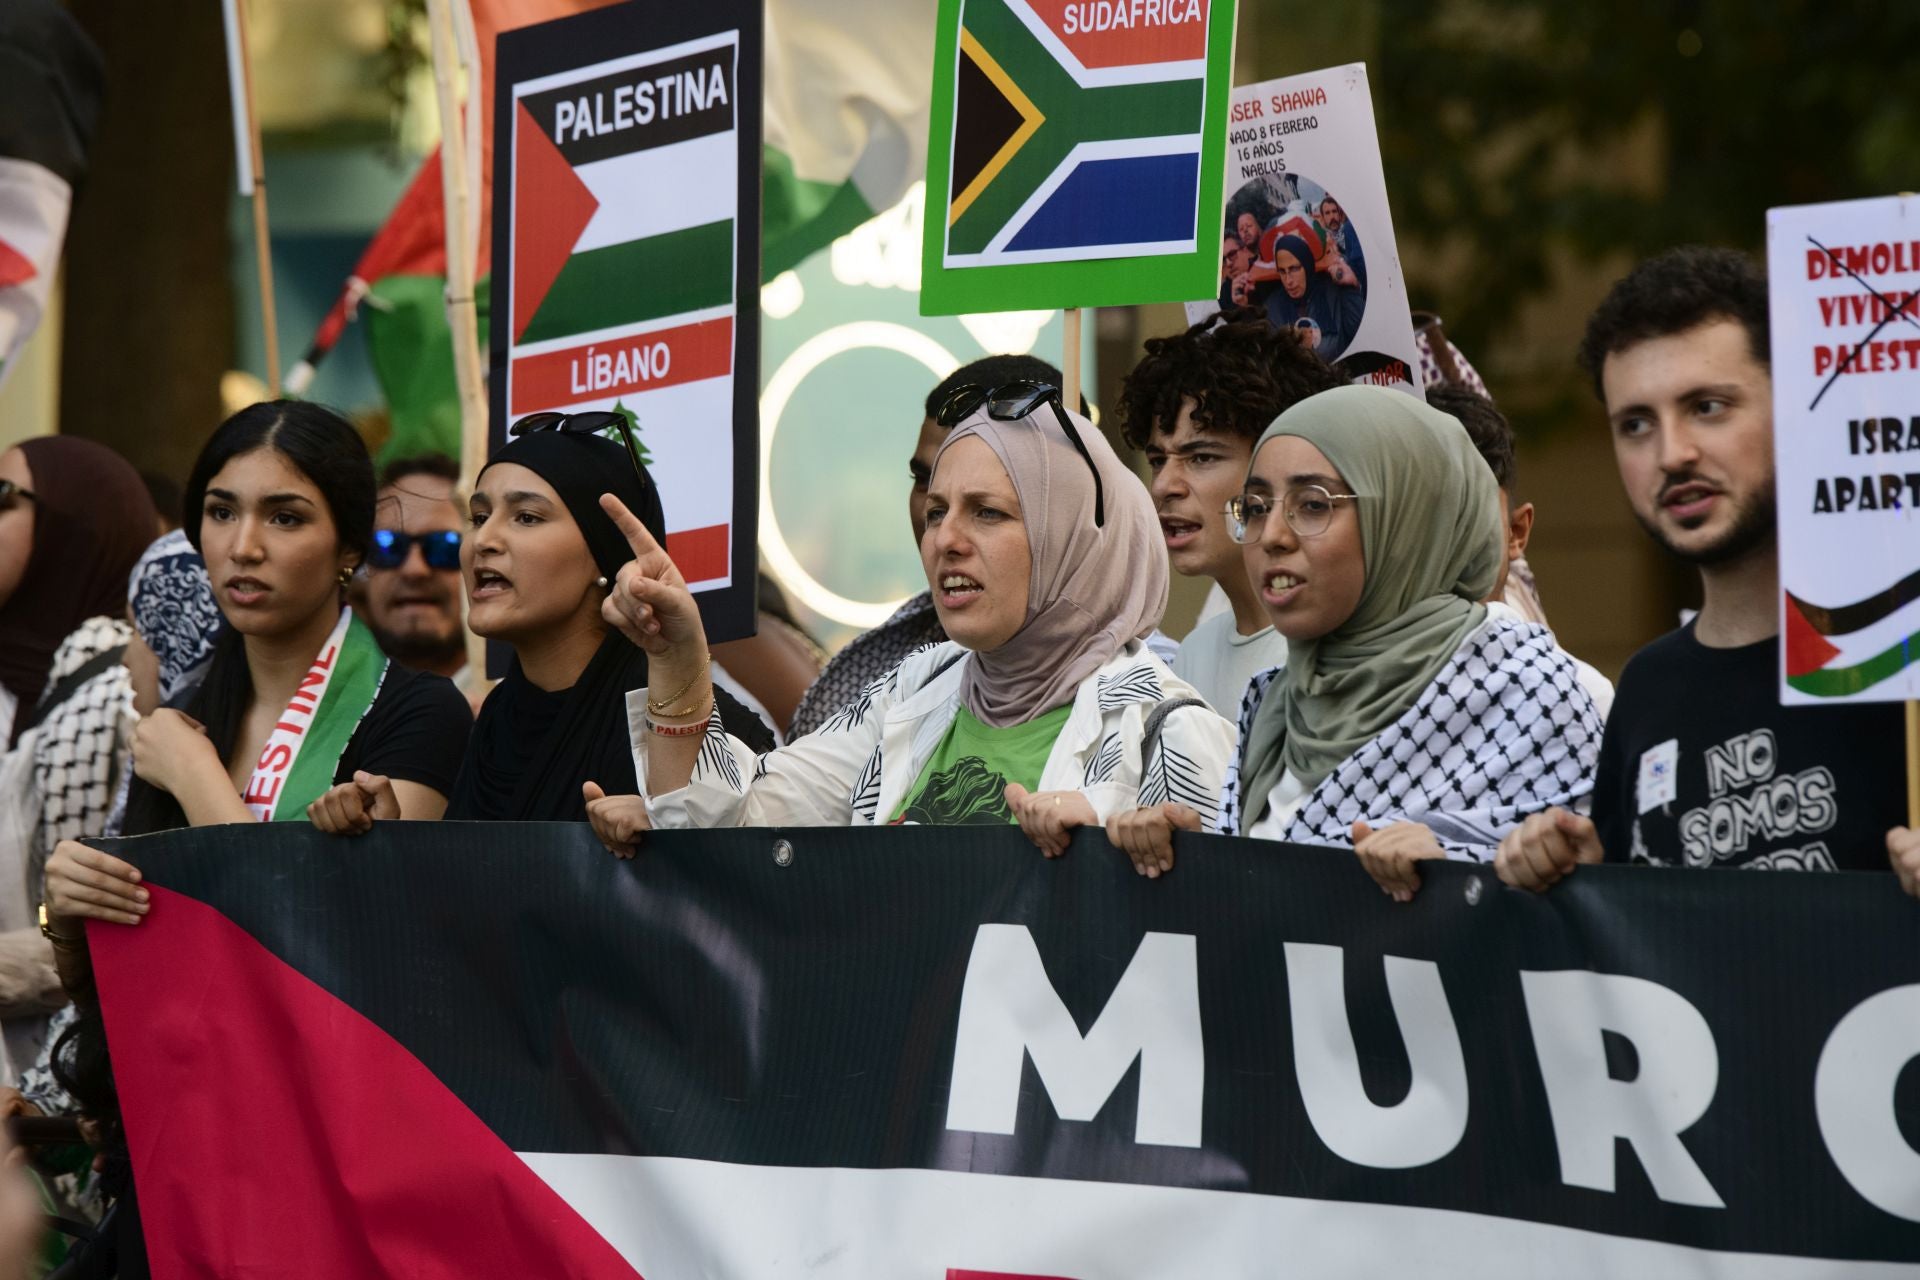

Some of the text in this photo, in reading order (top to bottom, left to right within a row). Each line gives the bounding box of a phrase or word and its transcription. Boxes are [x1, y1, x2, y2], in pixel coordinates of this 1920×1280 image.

[555, 64, 728, 145] PALESTINA
[1271, 86, 1327, 114] SHAWA
[1259, 126, 1267, 139] 8
[1269, 115, 1318, 137] FEBRERO
[1238, 140, 1284, 161] 16 AÑOS
[1241, 158, 1286, 178] NABLUS
[571, 342, 670, 394] LÍBANO
[1813, 338, 1920, 377] PALEST
[1848, 416, 1920, 455] ISRA
[1813, 473, 1920, 514] APART
[1704, 728, 1777, 799] NO
[1679, 766, 1837, 868] SOMOS
